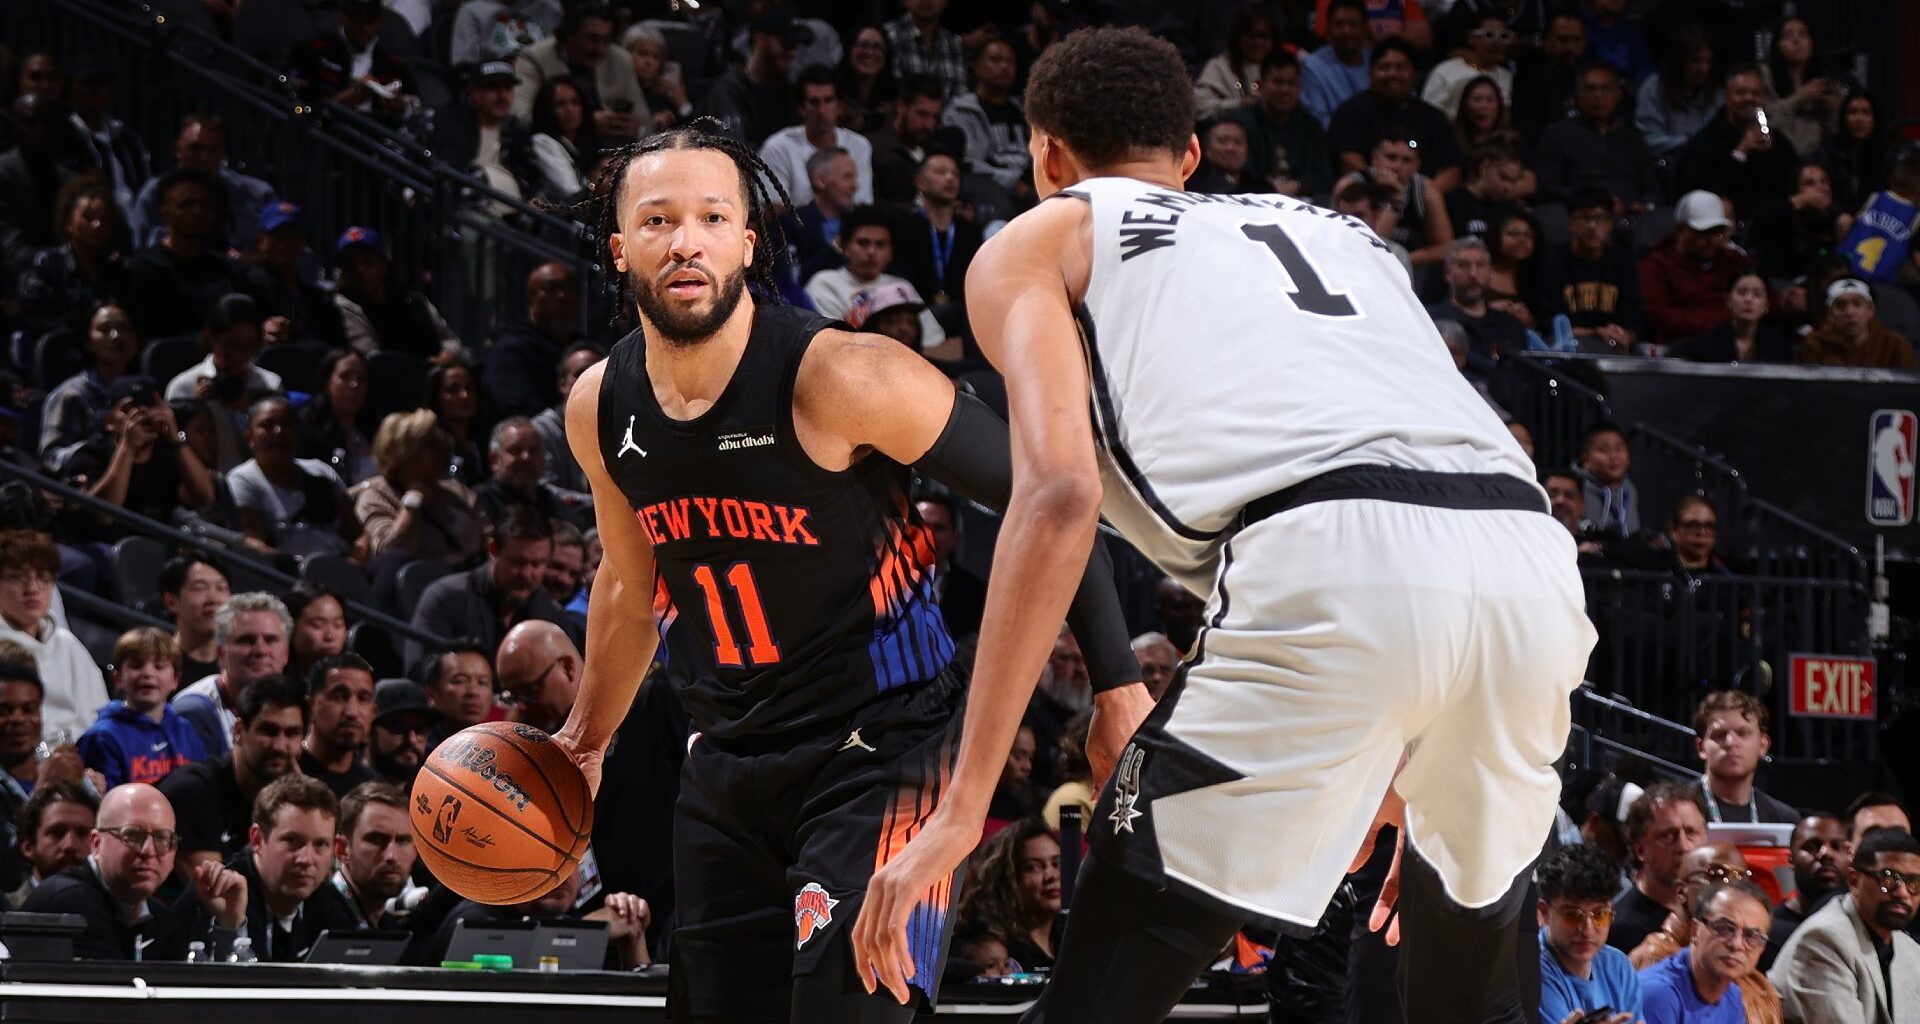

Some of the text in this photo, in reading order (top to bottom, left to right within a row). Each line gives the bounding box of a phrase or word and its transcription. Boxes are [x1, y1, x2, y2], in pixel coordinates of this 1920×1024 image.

[1238, 221, 1361, 318] 1
[1856, 236, 1888, 273] 4
[718, 433, 775, 451] abu dhabi
[692, 496, 820, 546] YORK
[690, 561, 783, 669] 11
[1806, 661, 1864, 714] EXIT
[438, 738, 533, 814] Wilson
